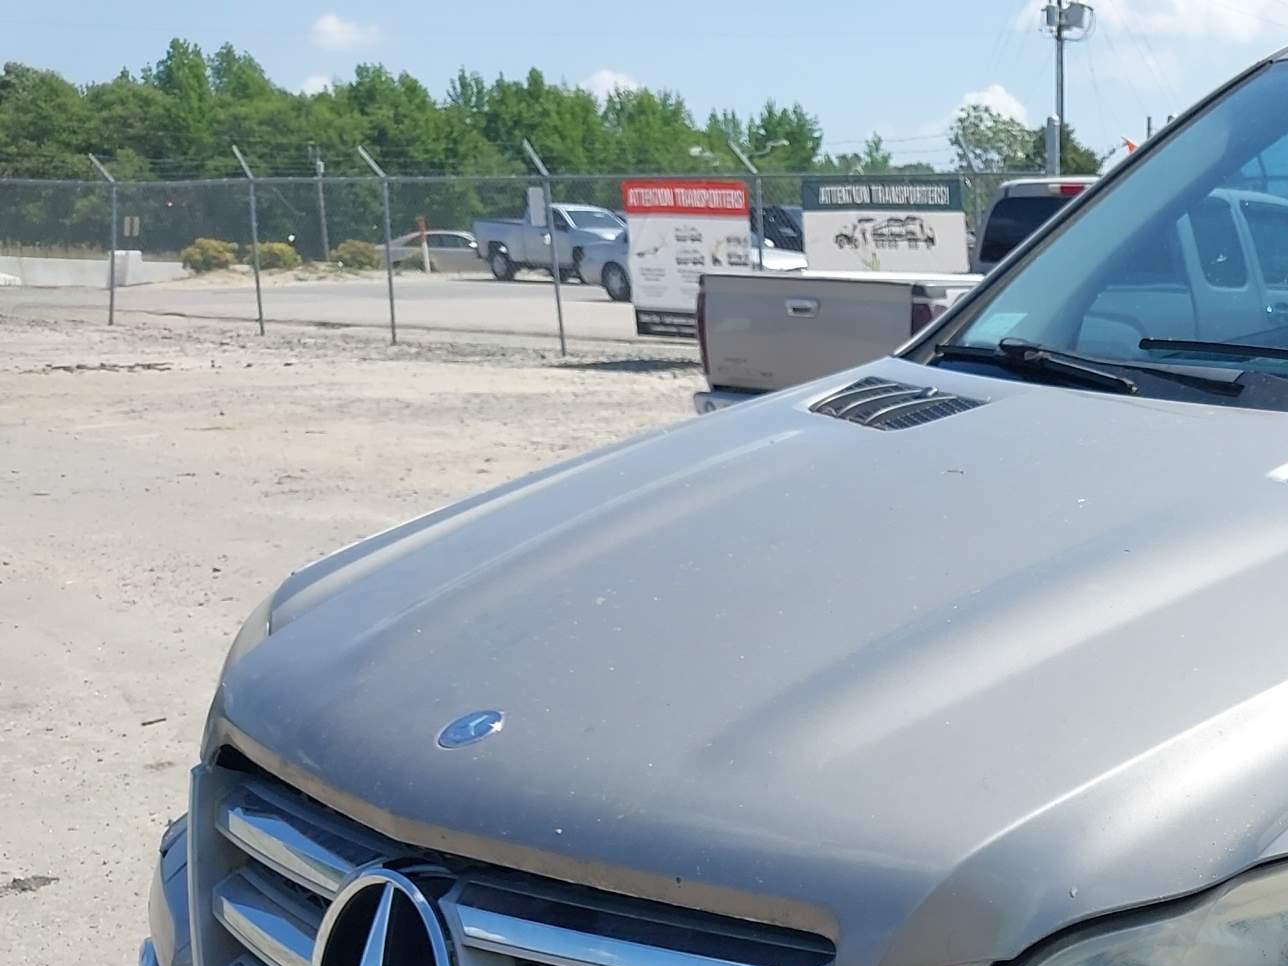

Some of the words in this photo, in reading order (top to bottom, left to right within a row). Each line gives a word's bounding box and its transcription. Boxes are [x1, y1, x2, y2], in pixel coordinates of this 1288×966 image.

[628, 187, 674, 207] ATTENTION
[818, 185, 871, 205] ATTENTION
[871, 184, 950, 205] TRANSPORTERS!
